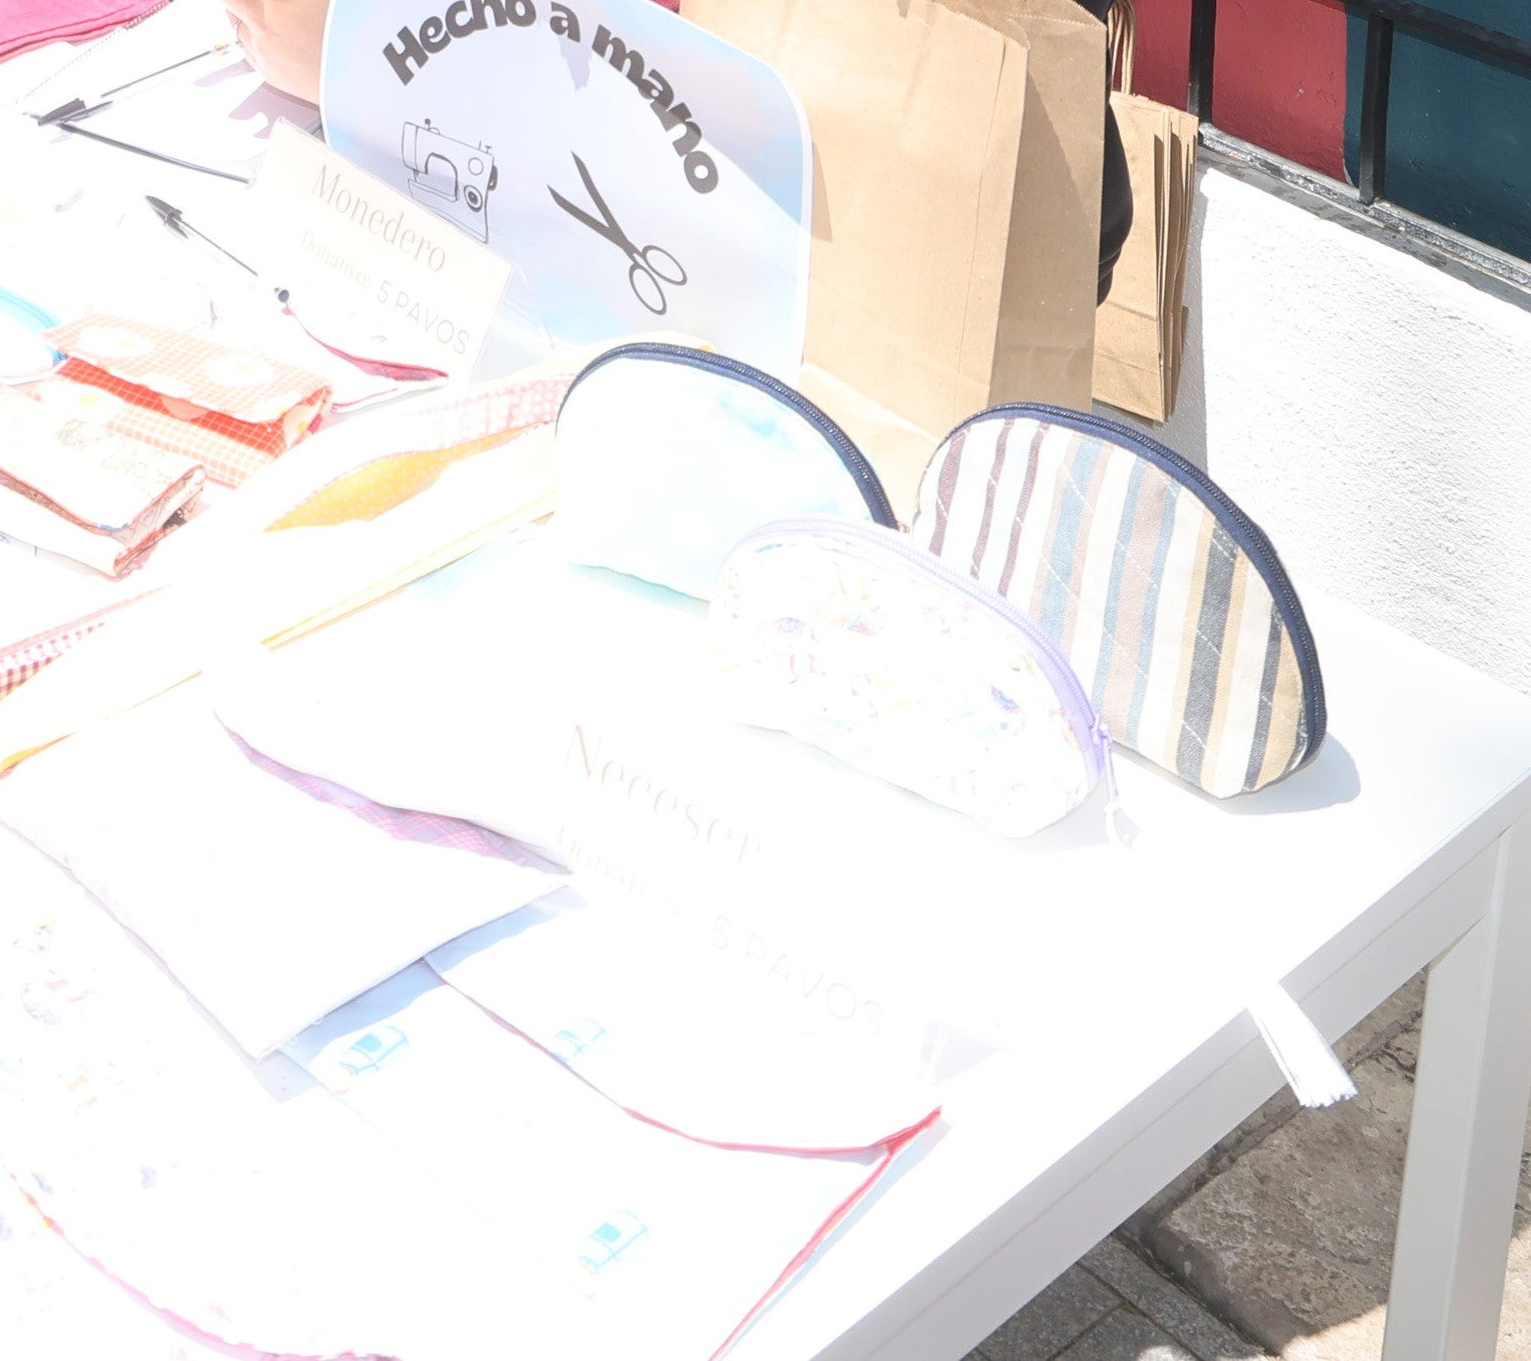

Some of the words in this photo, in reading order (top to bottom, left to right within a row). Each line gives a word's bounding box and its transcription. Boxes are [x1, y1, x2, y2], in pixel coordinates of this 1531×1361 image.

[549, 0, 582, 44] a
[590, 23, 719, 194] mano
[311, 164, 447, 273] Monedero
[376, 279, 389, 305] 5
[394, 289, 471, 355] PAVOS
[741, 933, 887, 1039] PAVOS
